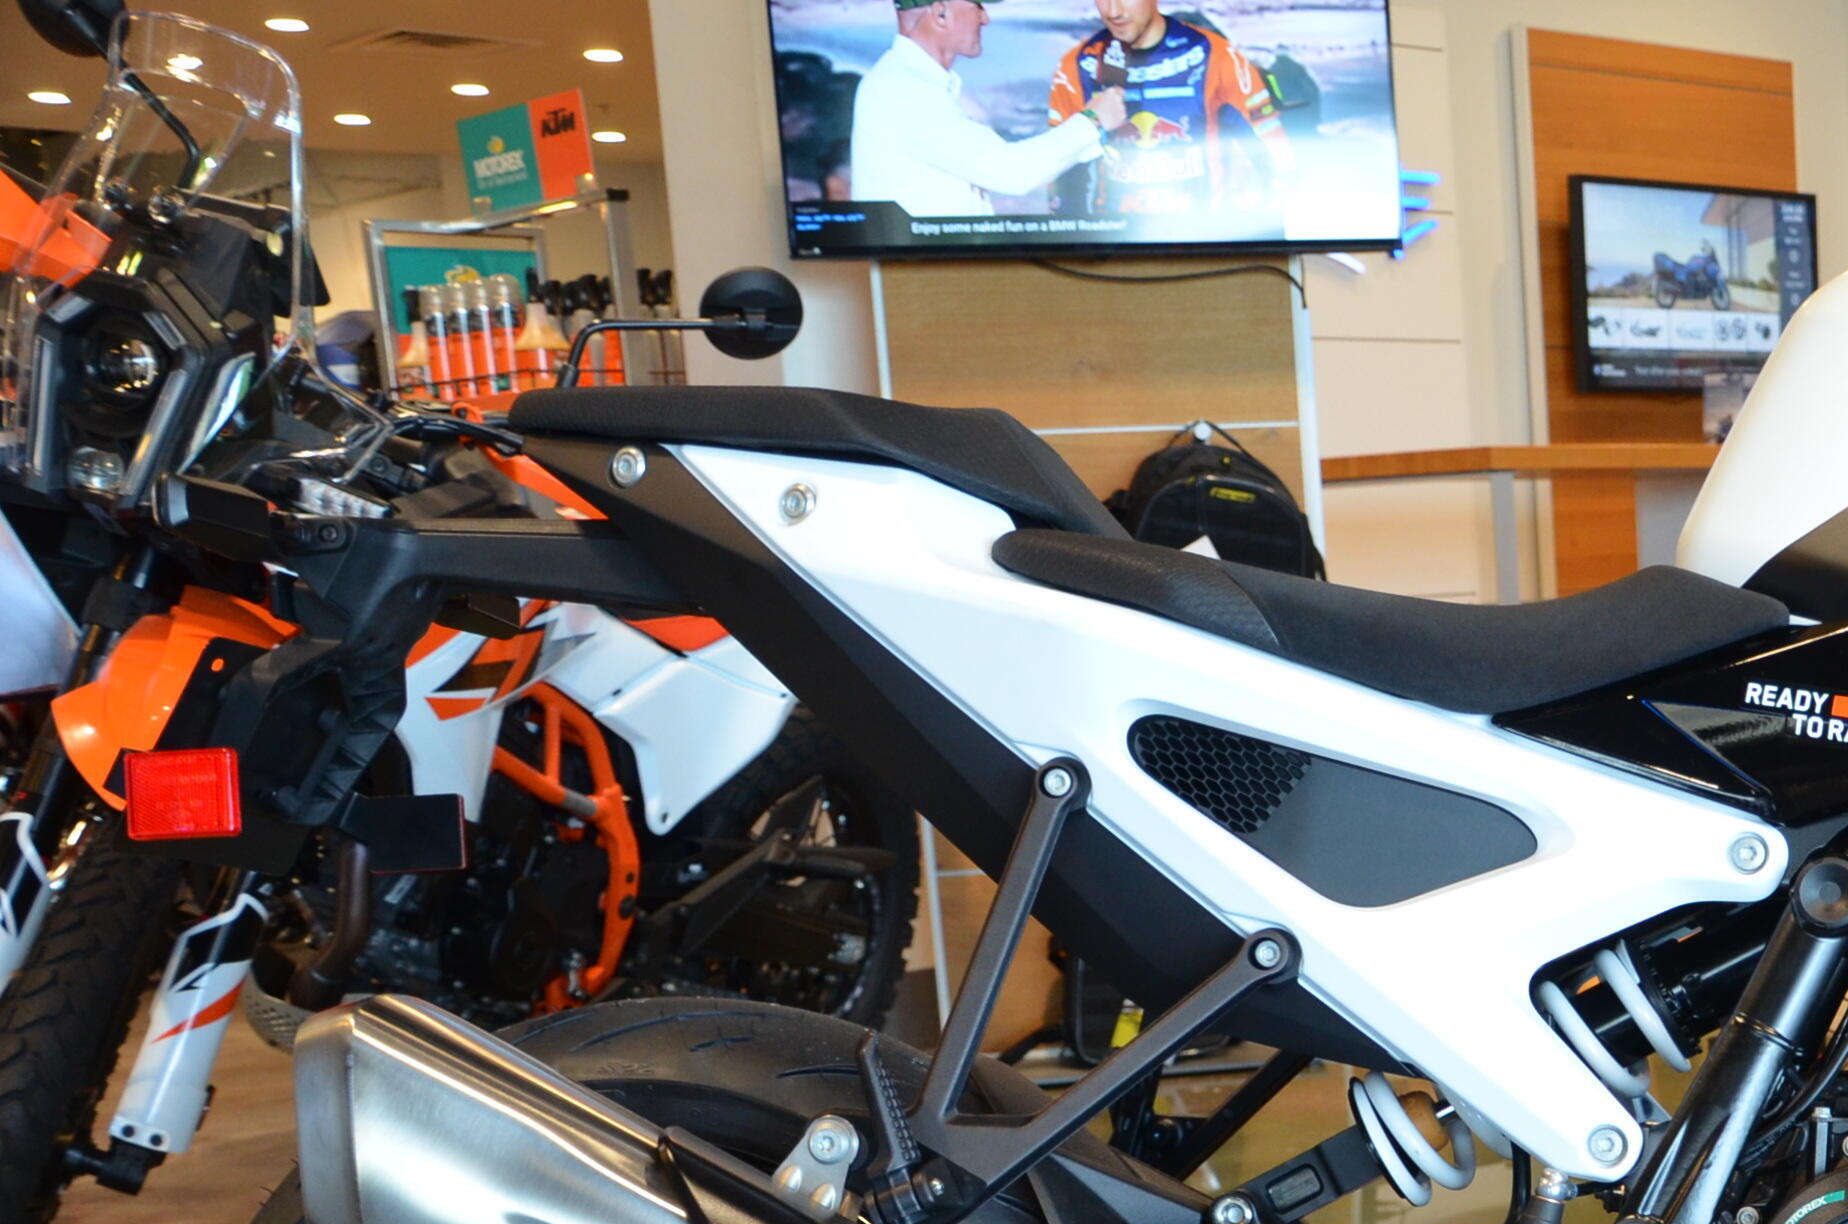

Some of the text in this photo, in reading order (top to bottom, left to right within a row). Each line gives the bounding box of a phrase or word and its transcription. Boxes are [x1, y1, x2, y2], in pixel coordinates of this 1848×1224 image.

[541, 107, 576, 138] KTM
[911, 221, 940, 236] Enjoy
[972, 221, 1004, 233] naked
[1005, 220, 1023, 232] fun
[1025, 222, 1039, 232] on
[1744, 682, 1829, 714] READY
[1792, 713, 1824, 739] TO
